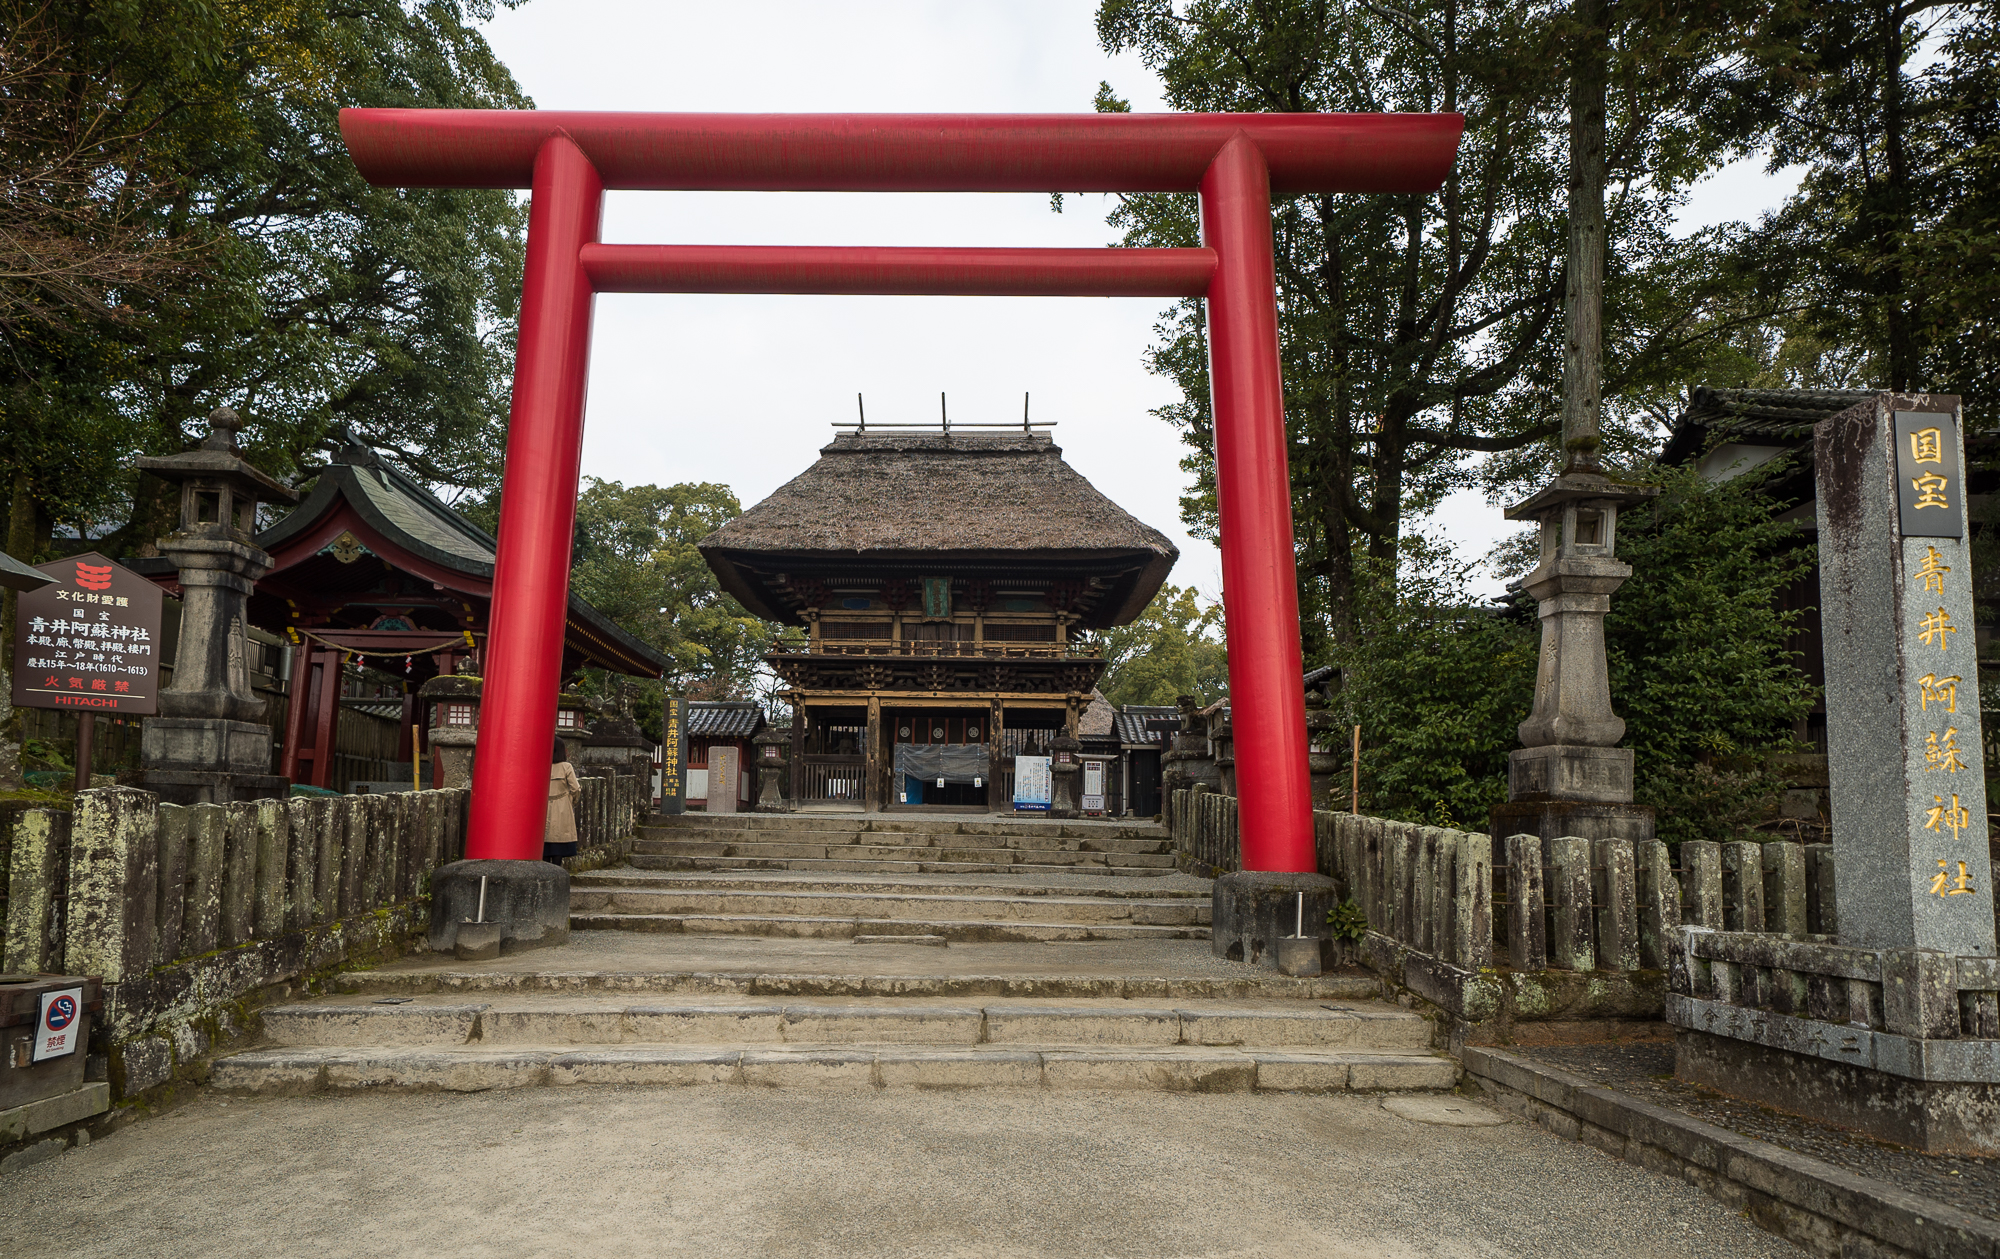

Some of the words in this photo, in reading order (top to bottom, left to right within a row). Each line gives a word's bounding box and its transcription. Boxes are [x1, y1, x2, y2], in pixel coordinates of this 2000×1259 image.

[1909, 426, 1949, 510] 国宝
[55, 589, 129, 608] 文化財愛護
[28, 616, 151, 642] 青井阿蘇神社
[44, 675, 130, 692] 火気厳禁
[55, 696, 118, 708] HITACHI
[1913, 545, 1976, 899] 青井阿蘇神社
